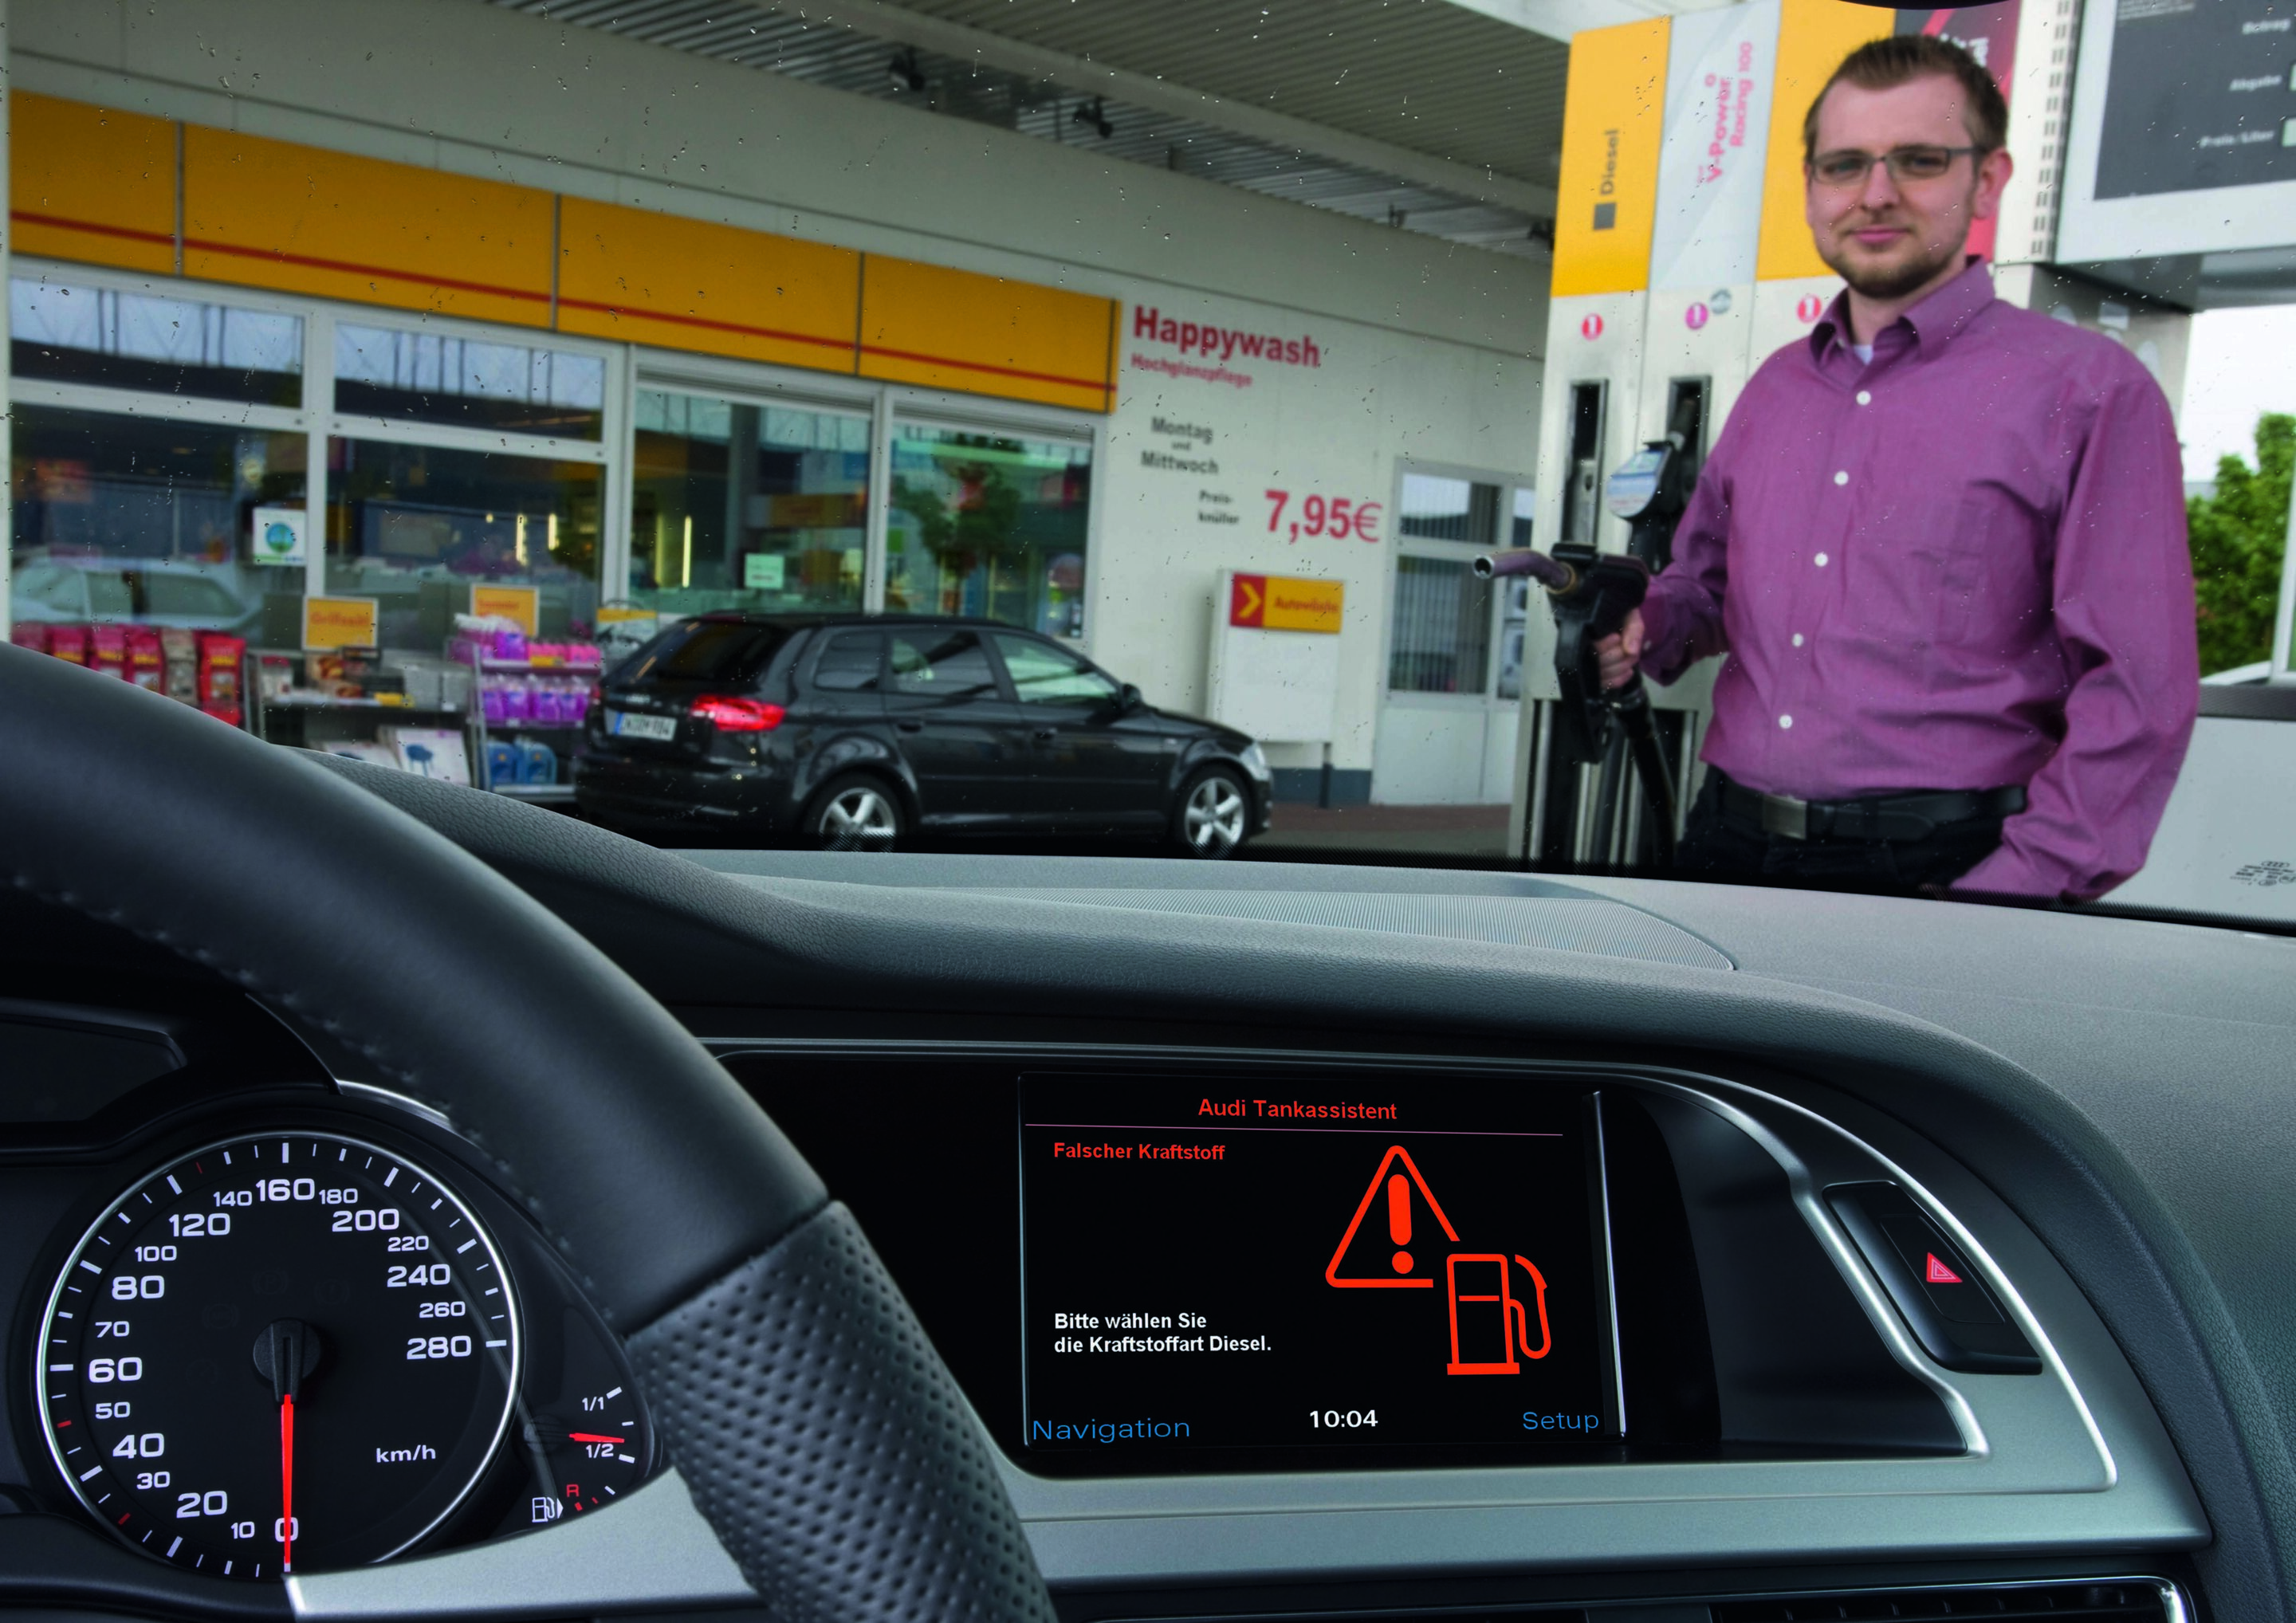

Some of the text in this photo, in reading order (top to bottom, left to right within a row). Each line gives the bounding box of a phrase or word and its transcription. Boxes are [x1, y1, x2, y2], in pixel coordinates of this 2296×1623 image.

[1707, 78, 1731, 183] V-Power
[1601, 129, 1619, 195] Diesel
[1134, 305, 1320, 367] Happywash
[1151, 417, 1213, 444] Montag
[1141, 450, 1219, 474] Mittwoch
[1264, 489, 1383, 544] 7,95€
[1199, 1099, 1397, 1119] Audi Tankassistent
[1055, 1142, 1225, 1159] Falscher Kraftstoff
[213, 1191, 252, 1207] 140
[256, 1178, 315, 1201] 160
[319, 1189, 358, 1204] 180
[168, 1213, 230, 1237] 120
[332, 1208, 399, 1232] 200
[135, 1245, 177, 1262] 100
[387, 1236, 429, 1252] 220
[387, 1263, 450, 1287] 240
[112, 1275, 164, 1300] 80
[419, 1301, 466, 1318] 260
[95, 1321, 129, 1338] 70
[1056, 1313, 1206, 1329] Bitte wählen Sie
[407, 1335, 471, 1360] 280
[1055, 1335, 1271, 1352] die Kraftstoffart Diesel.
[88, 1357, 142, 1383] 60
[95, 1401, 130, 1419] 50
[582, 1397, 603, 1411] 1/1
[1310, 1410, 1378, 1428] 10:04
[1523, 1412, 1598, 1432] Setup
[1034, 1418, 1189, 1443] Navigation
[112, 1433, 164, 1459] 40
[376, 1444, 435, 1463] km/h
[586, 1442, 615, 1458] 1/2
[136, 1472, 170, 1490] 30
[567, 1484, 579, 1497] R
[176, 1491, 227, 1519] 20
[230, 1522, 255, 1539] 10
[275, 1517, 298, 1542] 0
